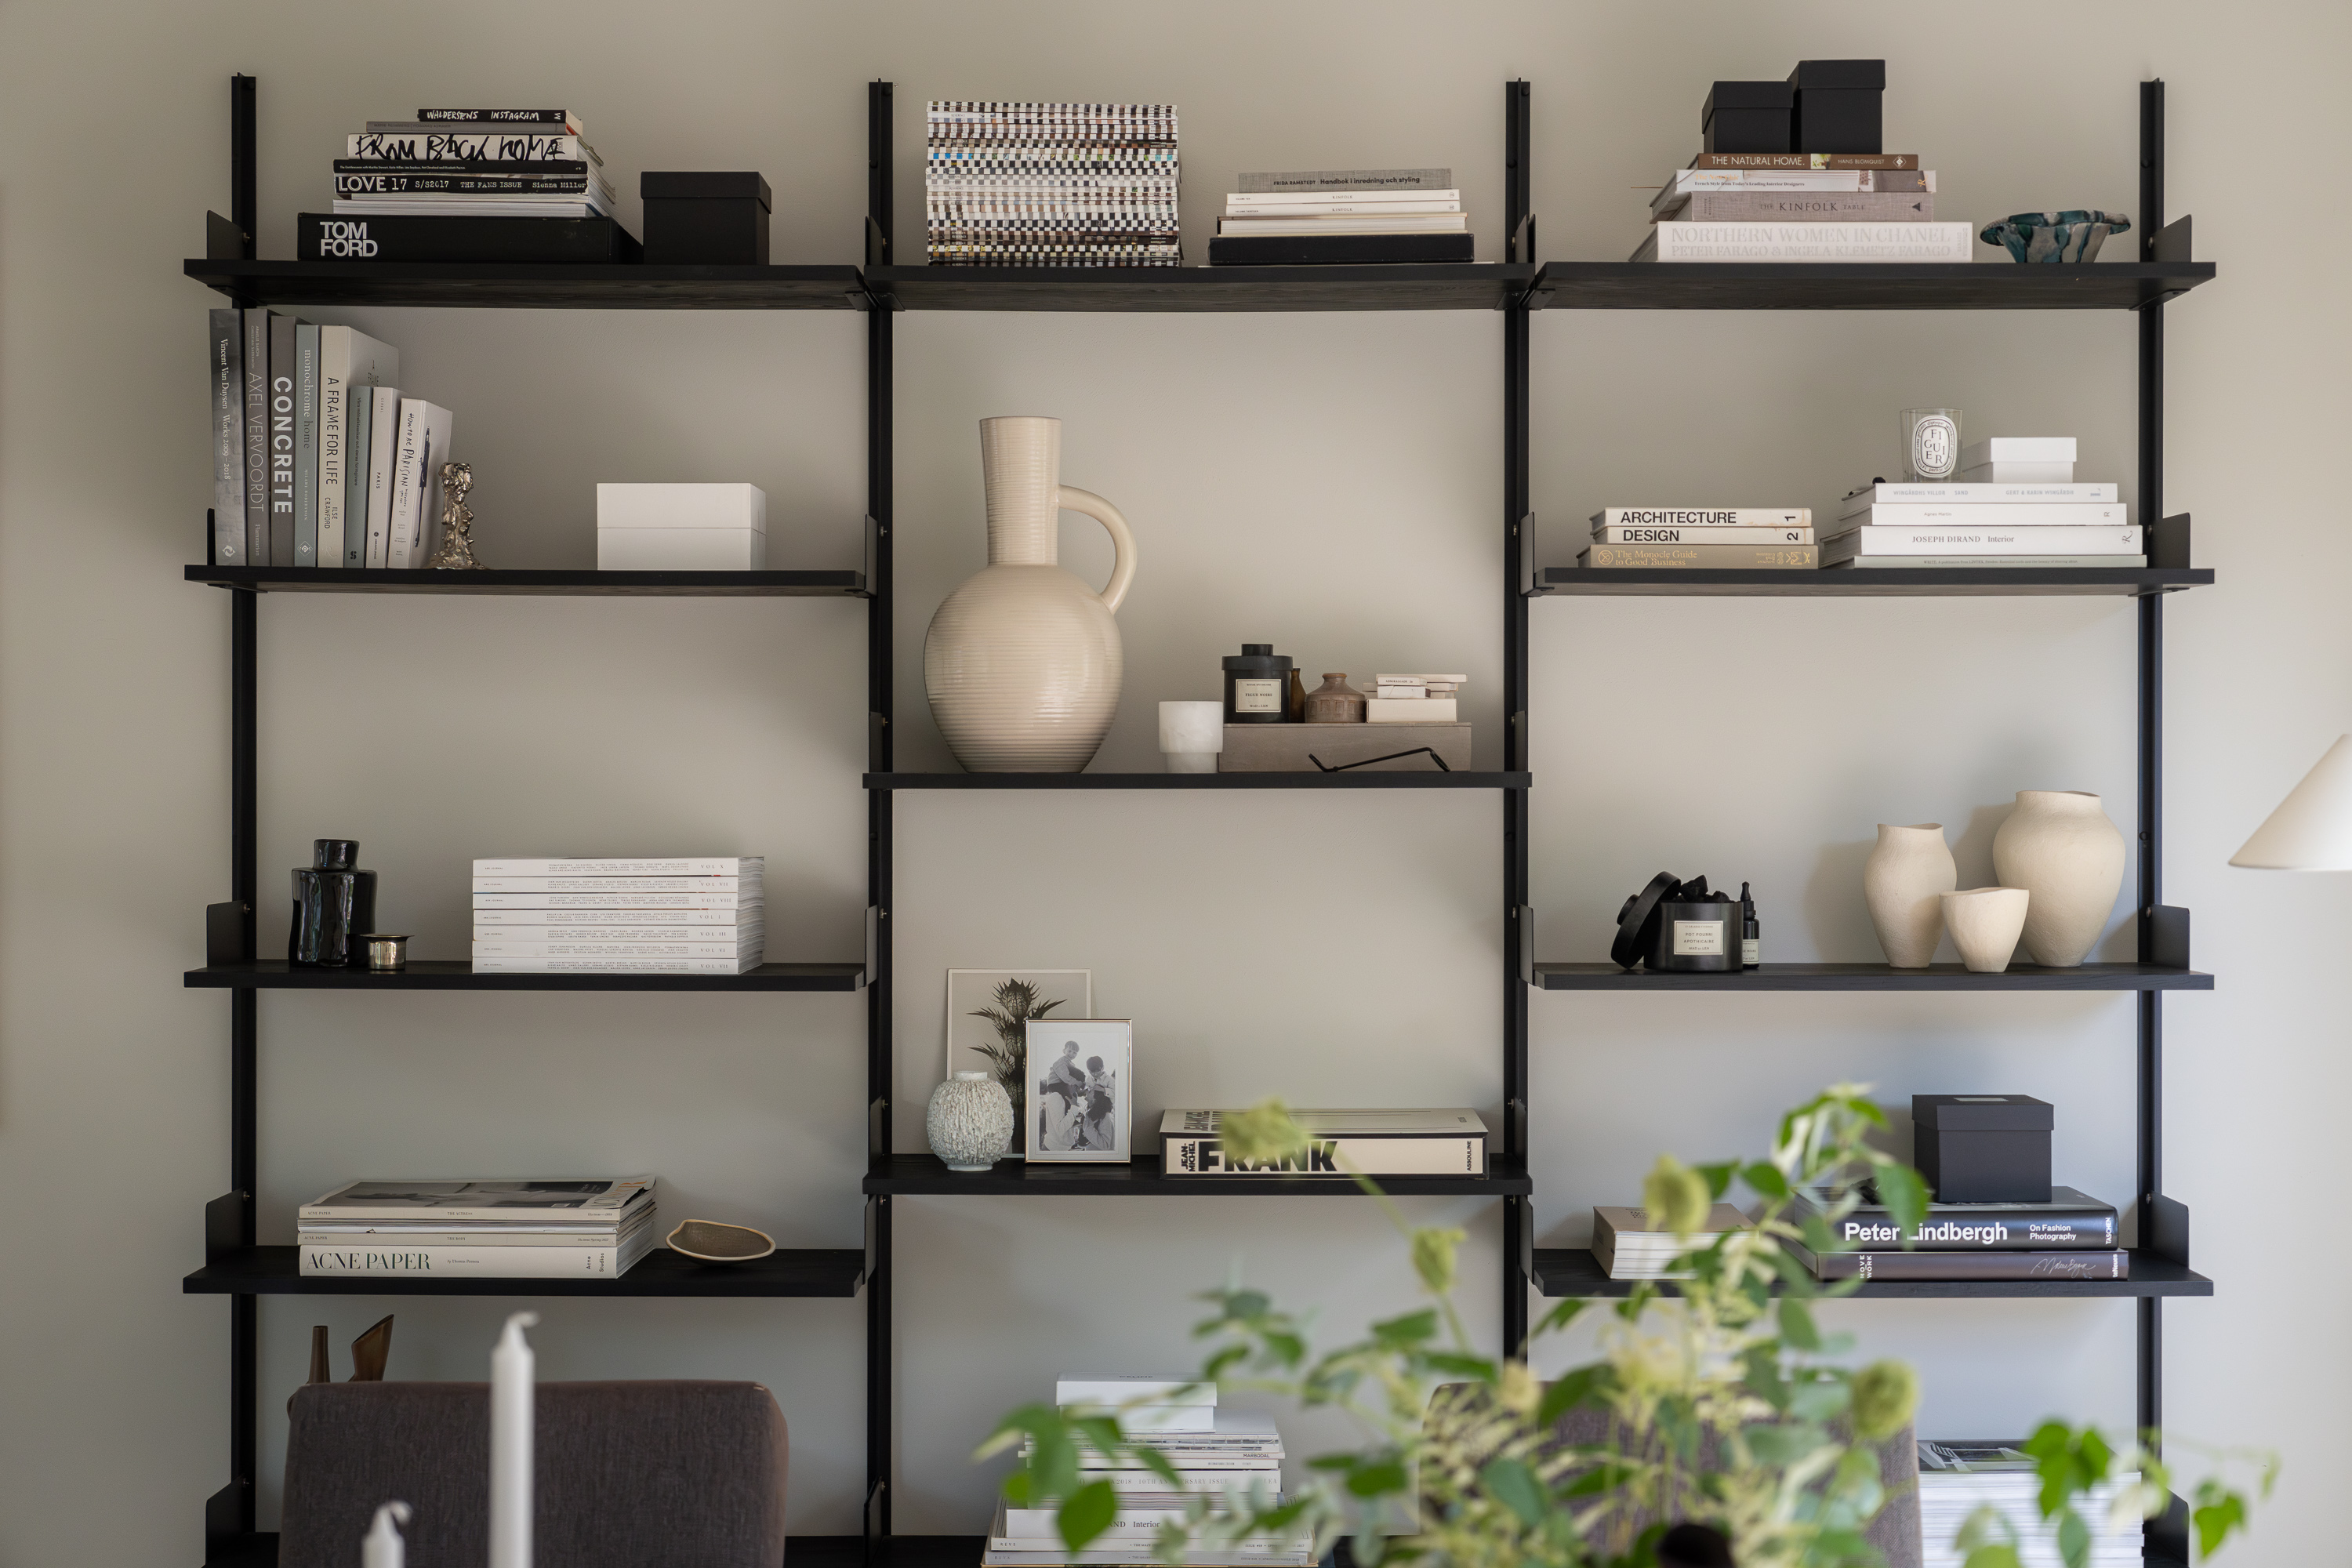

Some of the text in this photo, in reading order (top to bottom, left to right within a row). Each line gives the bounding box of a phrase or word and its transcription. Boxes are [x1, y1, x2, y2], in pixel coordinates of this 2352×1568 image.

[491, 111, 539, 121] INSTAGRAM
[355, 134, 565, 161] FROM BACK HOME
[1711, 156, 1805, 165] THE NATURAL HOME.
[338, 176, 387, 191] LOVE
[392, 178, 407, 191] 17
[415, 180, 449, 189] S/S2017
[1779, 202, 1838, 211] KINFOLK
[320, 221, 367, 239] TOM
[1671, 227, 1773, 242] NORTHERN
[1779, 227, 1848, 242] WOMEN
[1854, 227, 1872, 242] IN
[1876, 227, 1951, 242] CHANEL
[321, 239, 379, 257] FORD
[1671, 245, 1951, 256] PETER FARAGO & INGELA KLEMETZ FARAGO
[220, 383, 230, 409] Duysen
[303, 350, 314, 449] monochrome home
[325, 377, 339, 485] A FRAME FOR LIFE
[249, 372, 264, 512] AXEL VERVOORDT
[274, 376, 292, 513] CONCRETE
[1621, 511, 1737, 524] ARCHITECTURE
[1623, 529, 1798, 542] DESIGN 2
[1615, 550, 1632, 558] The
[1625, 557, 1648, 566] Good
[1845, 1222, 1900, 1241] Peter
[2029, 1232, 2077, 1241] Photography
[305, 1253, 432, 1270] ACNE PAPER
